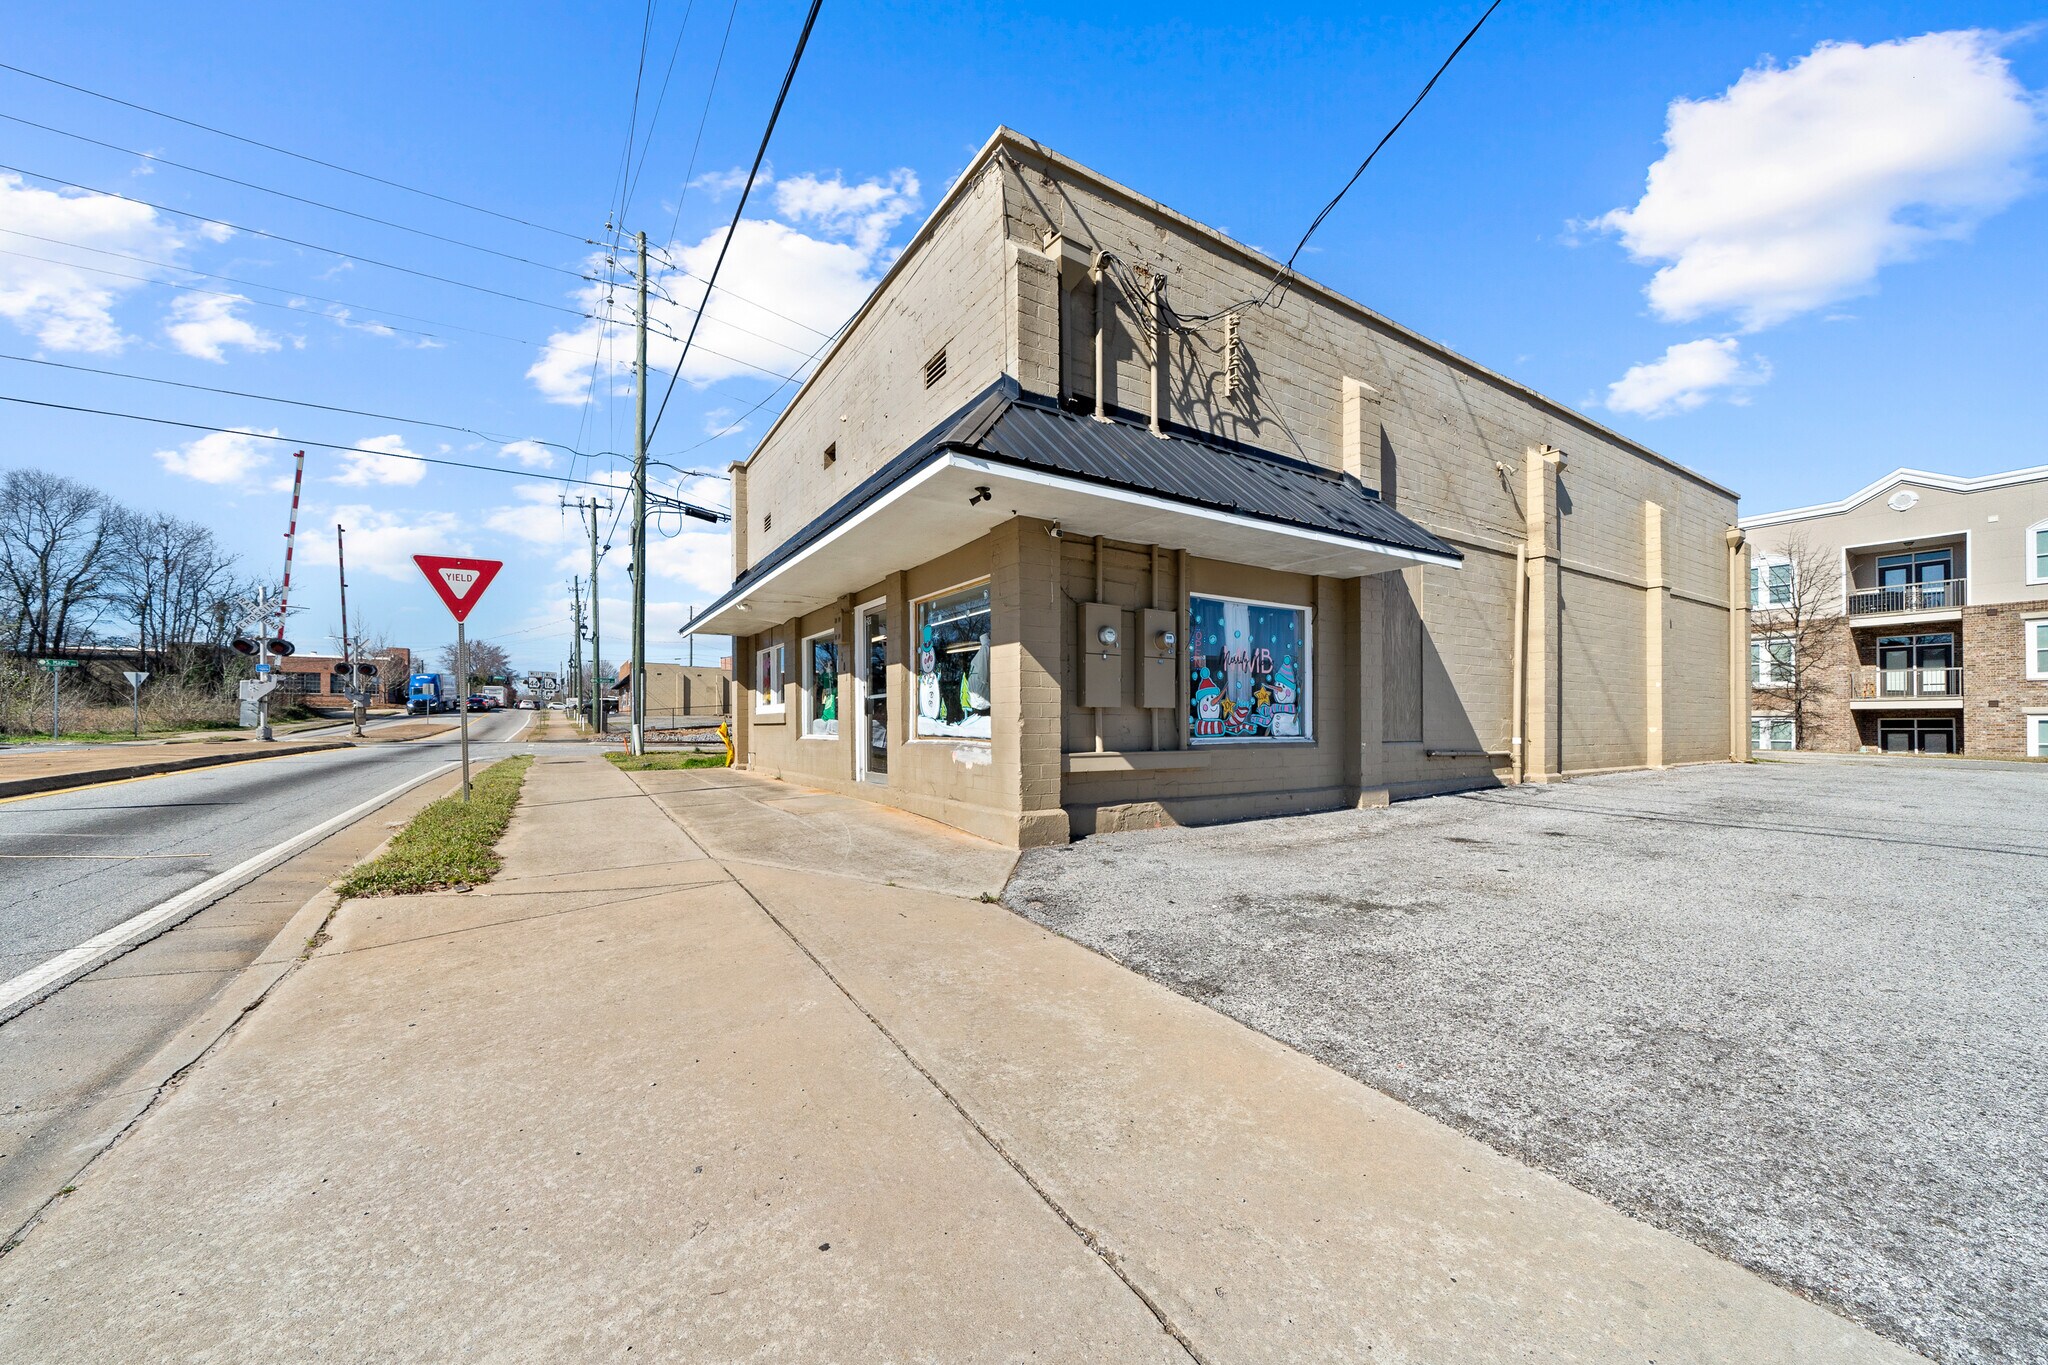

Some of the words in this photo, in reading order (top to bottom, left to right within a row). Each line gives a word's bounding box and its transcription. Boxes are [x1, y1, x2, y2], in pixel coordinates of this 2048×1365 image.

[446, 573, 473, 582] YIELD
[240, 599, 279, 629] CROSSING
[261, 615, 279, 630] ROAD
[1195, 631, 1203, 668] OPEN
